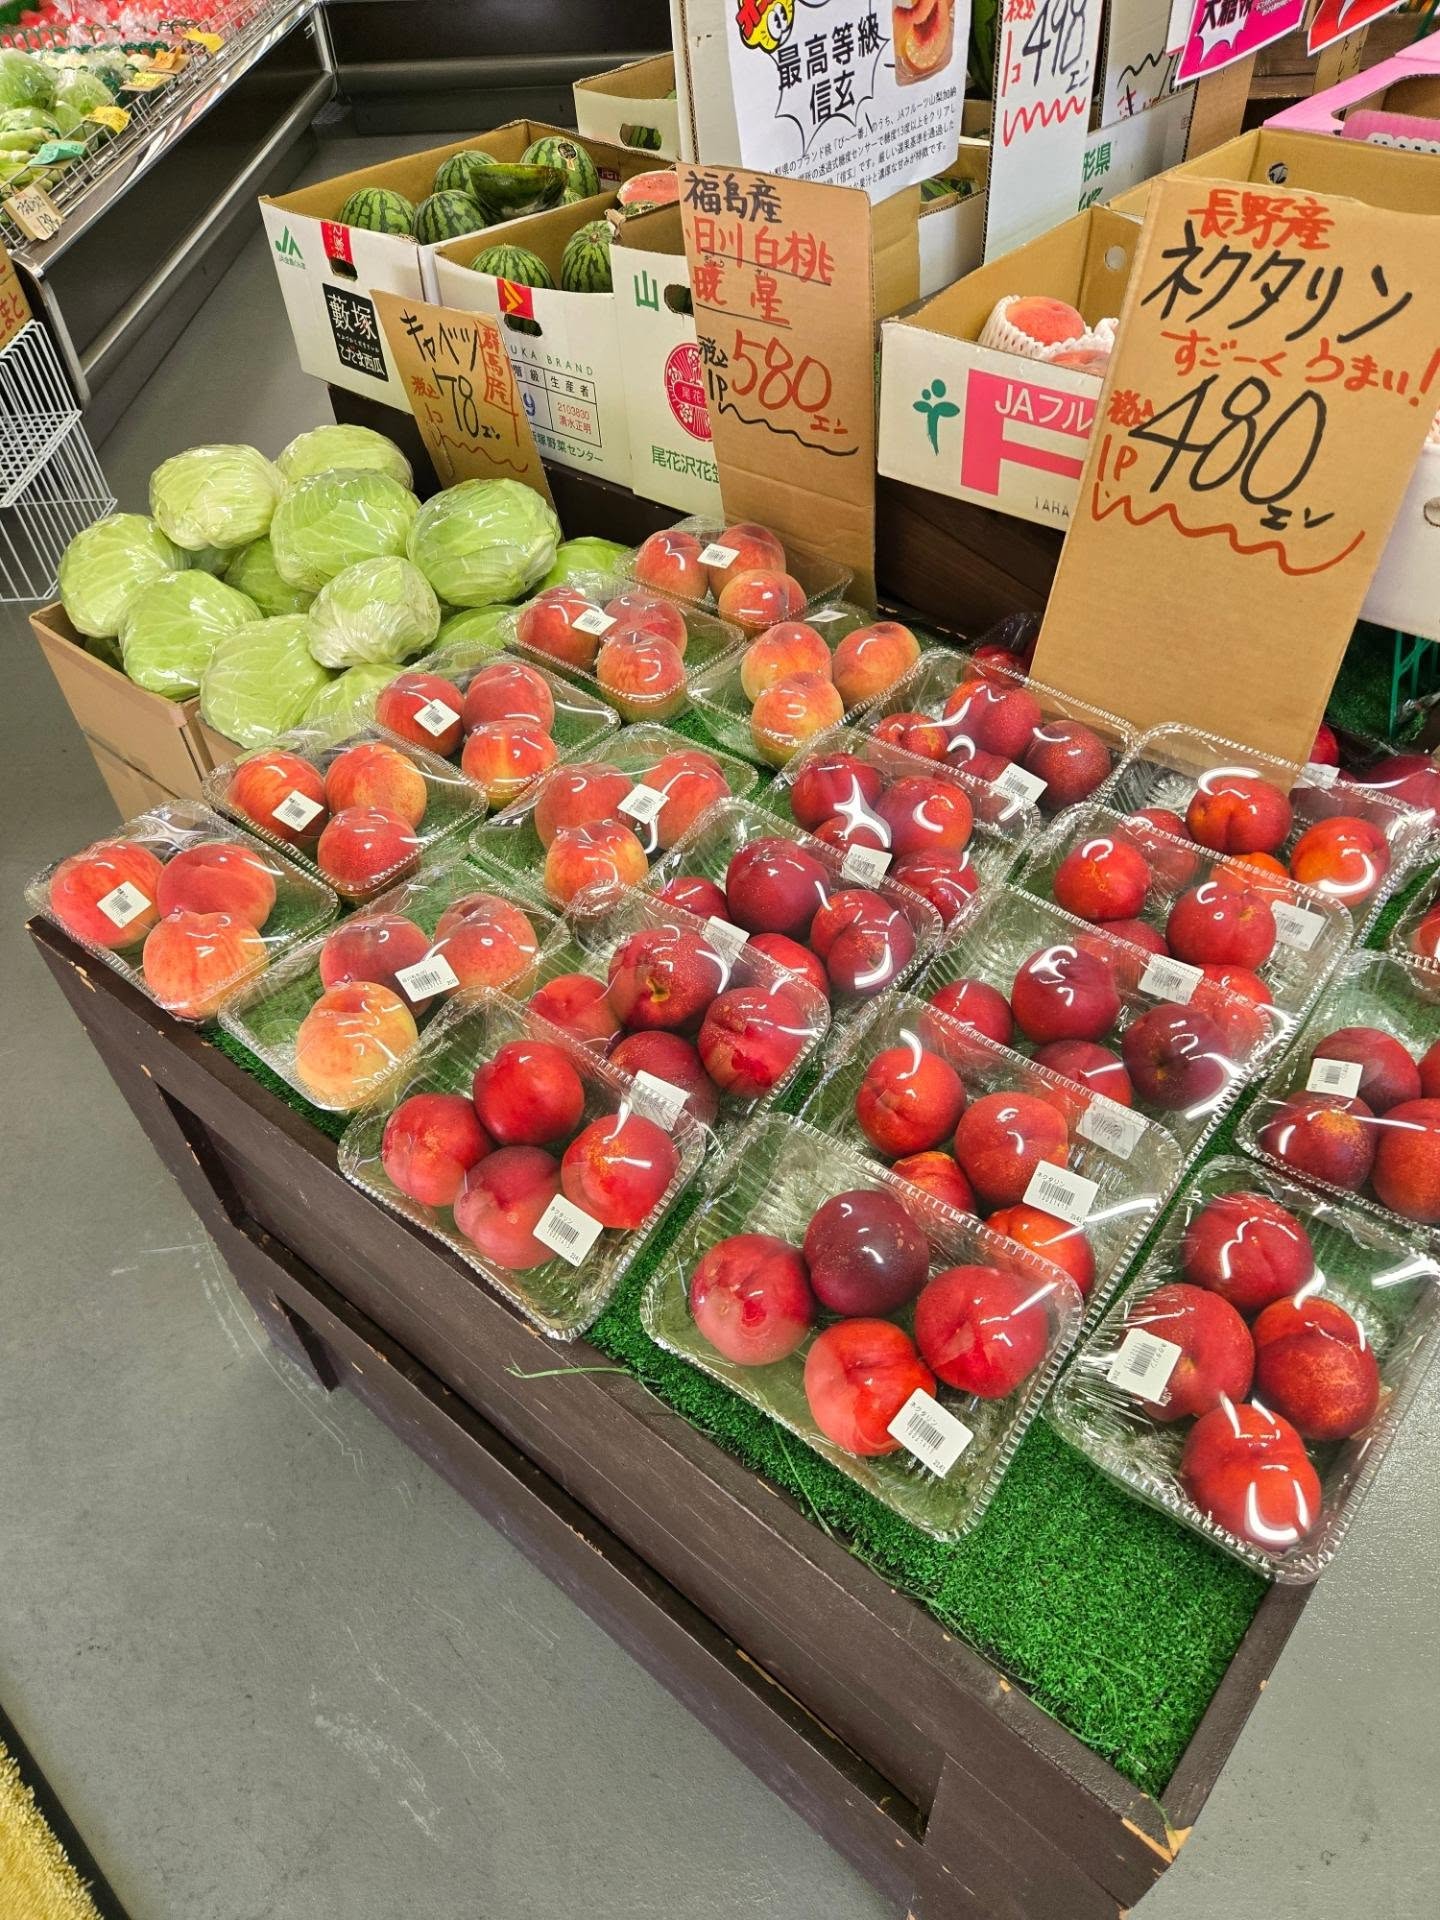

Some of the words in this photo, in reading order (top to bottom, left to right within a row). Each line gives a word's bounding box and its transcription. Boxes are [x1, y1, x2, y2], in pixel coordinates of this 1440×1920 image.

[777, 13, 881, 90] 最高等級
[810, 70, 855, 125] 信玄
[685, 173, 782, 223] 福島産
[1188, 189, 1335, 250] 長野産
[694, 216, 835, 283] 日川白桃
[634, 270, 660, 312] 山
[1141, 219, 1413, 343] ネクタリン
[400, 308, 479, 372] キャベツ
[546, 354, 594, 376] BRAND
[1161, 329, 1287, 377] すごーく
[550, 375, 590, 398] 生産者
[731, 329, 832, 413] 580
[994, 383, 1094, 433] JAフル
[1128, 374, 1327, 505] 480
